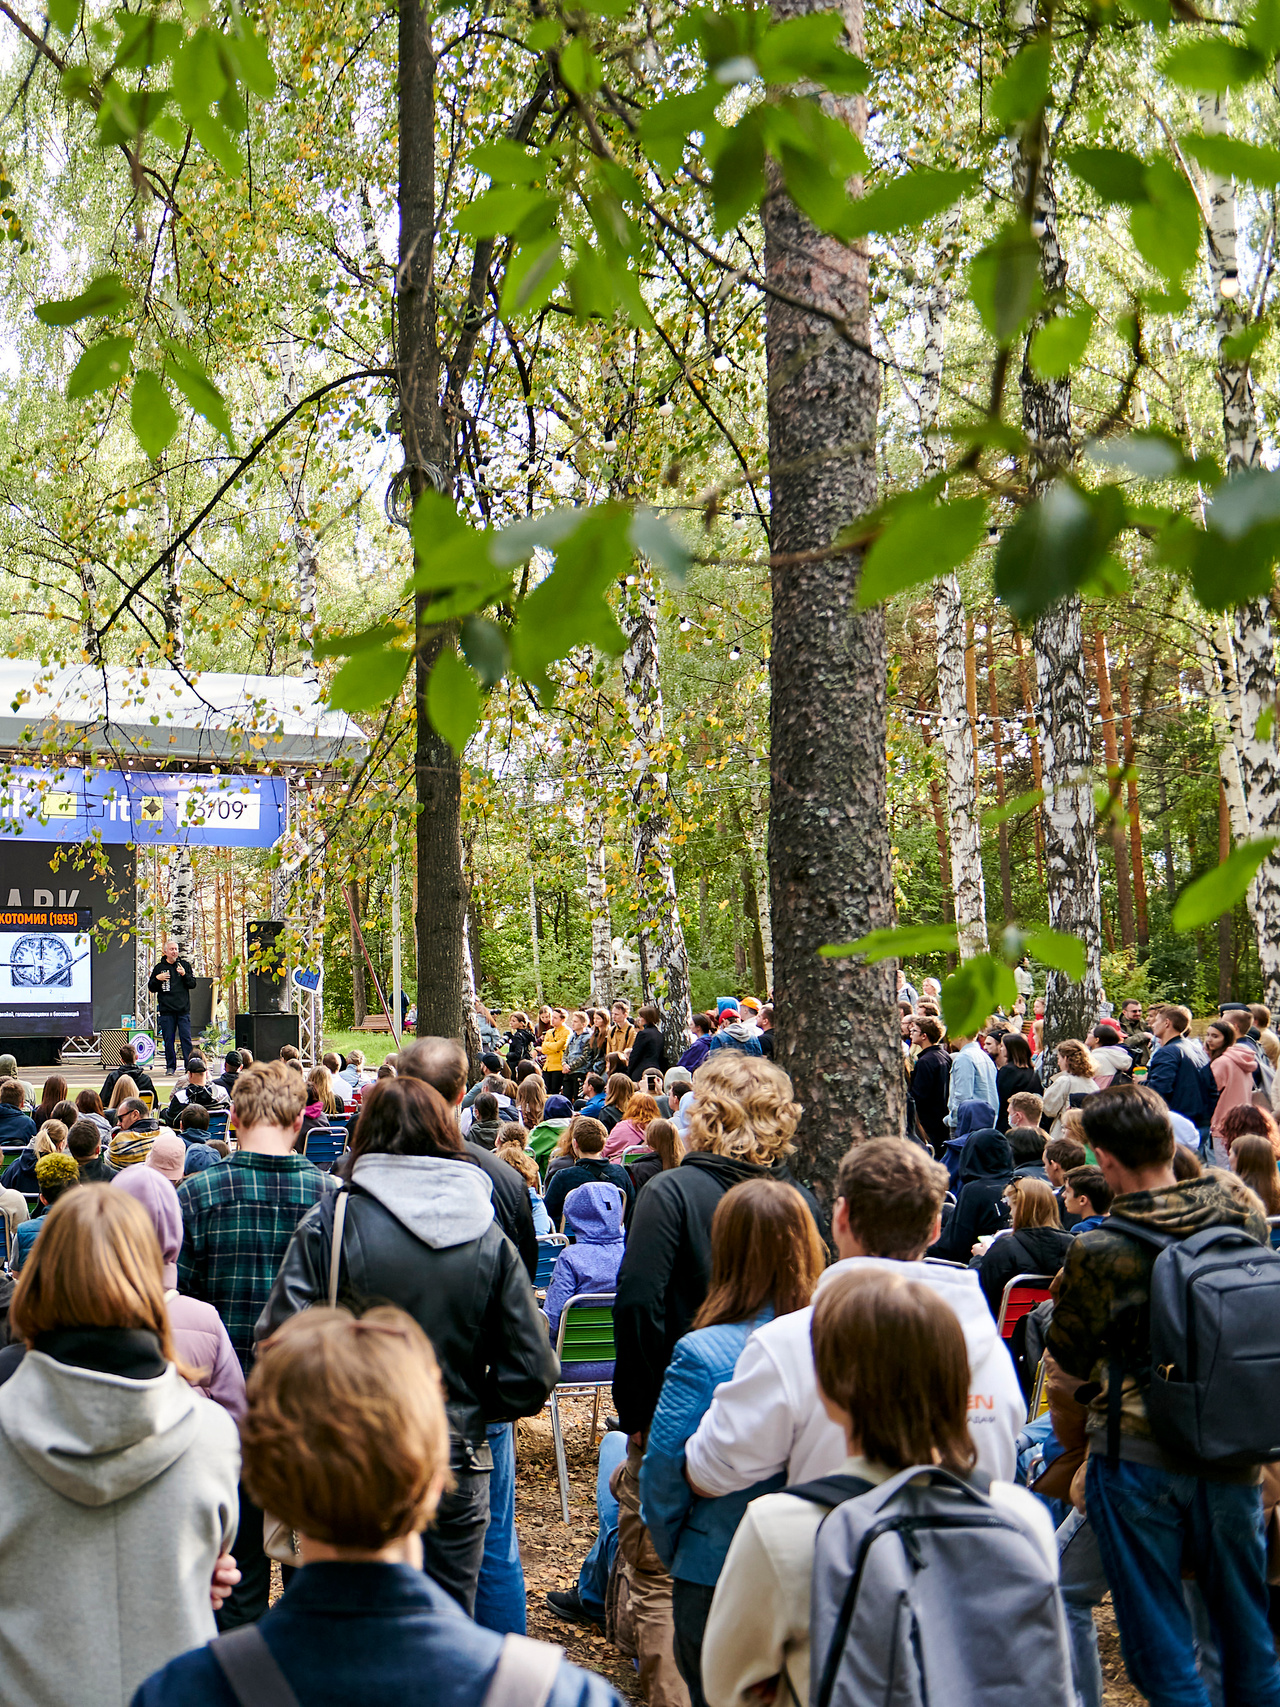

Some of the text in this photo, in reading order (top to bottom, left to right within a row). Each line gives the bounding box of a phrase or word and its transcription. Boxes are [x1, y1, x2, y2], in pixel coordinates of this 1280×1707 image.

[110, 791, 131, 821] it
[189, 800, 244, 820] 3/09
[50, 912, 78, 926] (1935)
